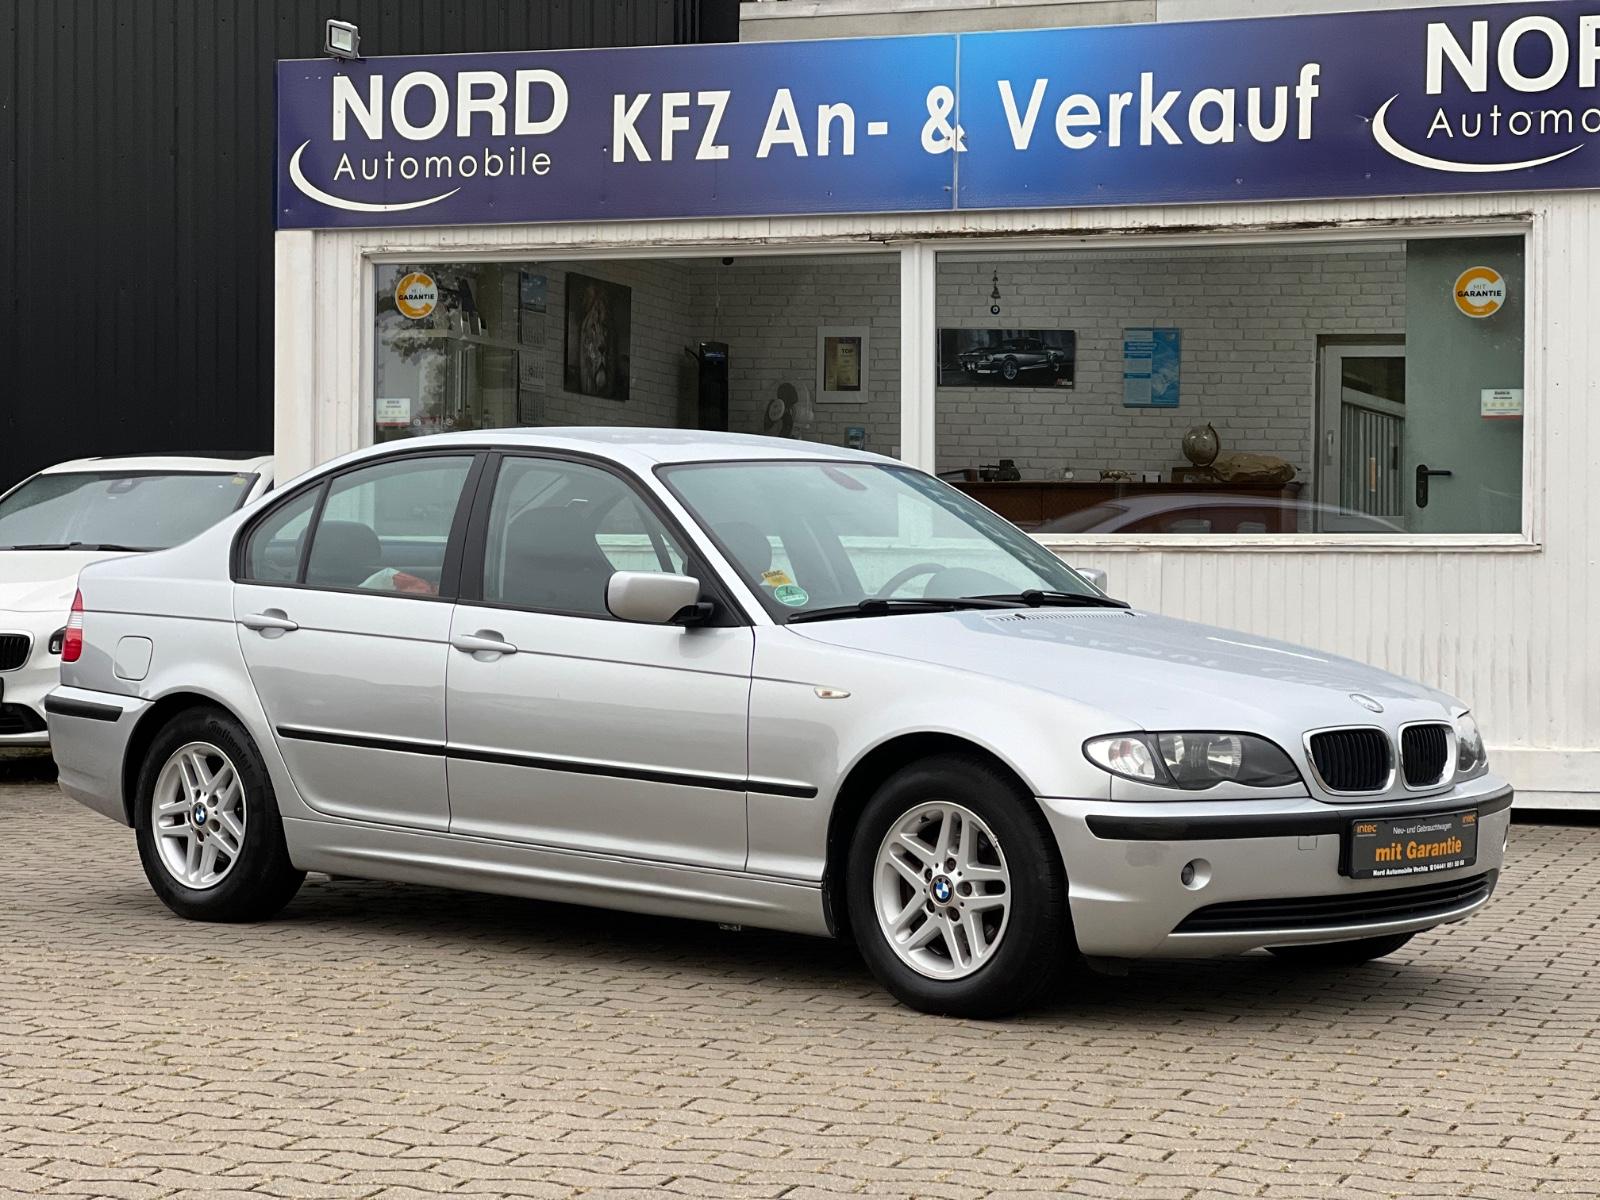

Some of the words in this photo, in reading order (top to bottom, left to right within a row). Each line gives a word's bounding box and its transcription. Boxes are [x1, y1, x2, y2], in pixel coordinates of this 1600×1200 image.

[333, 69, 569, 141] NORD
[612, 90, 731, 163] KFZ
[756, 87, 889, 159] An-
[920, 84, 968, 155] &
[997, 63, 1320, 150] Verkauf
[333, 146, 551, 181] Automobile
[1375, 842, 1402, 862] mit
[1406, 836, 1462, 859] Garantie
